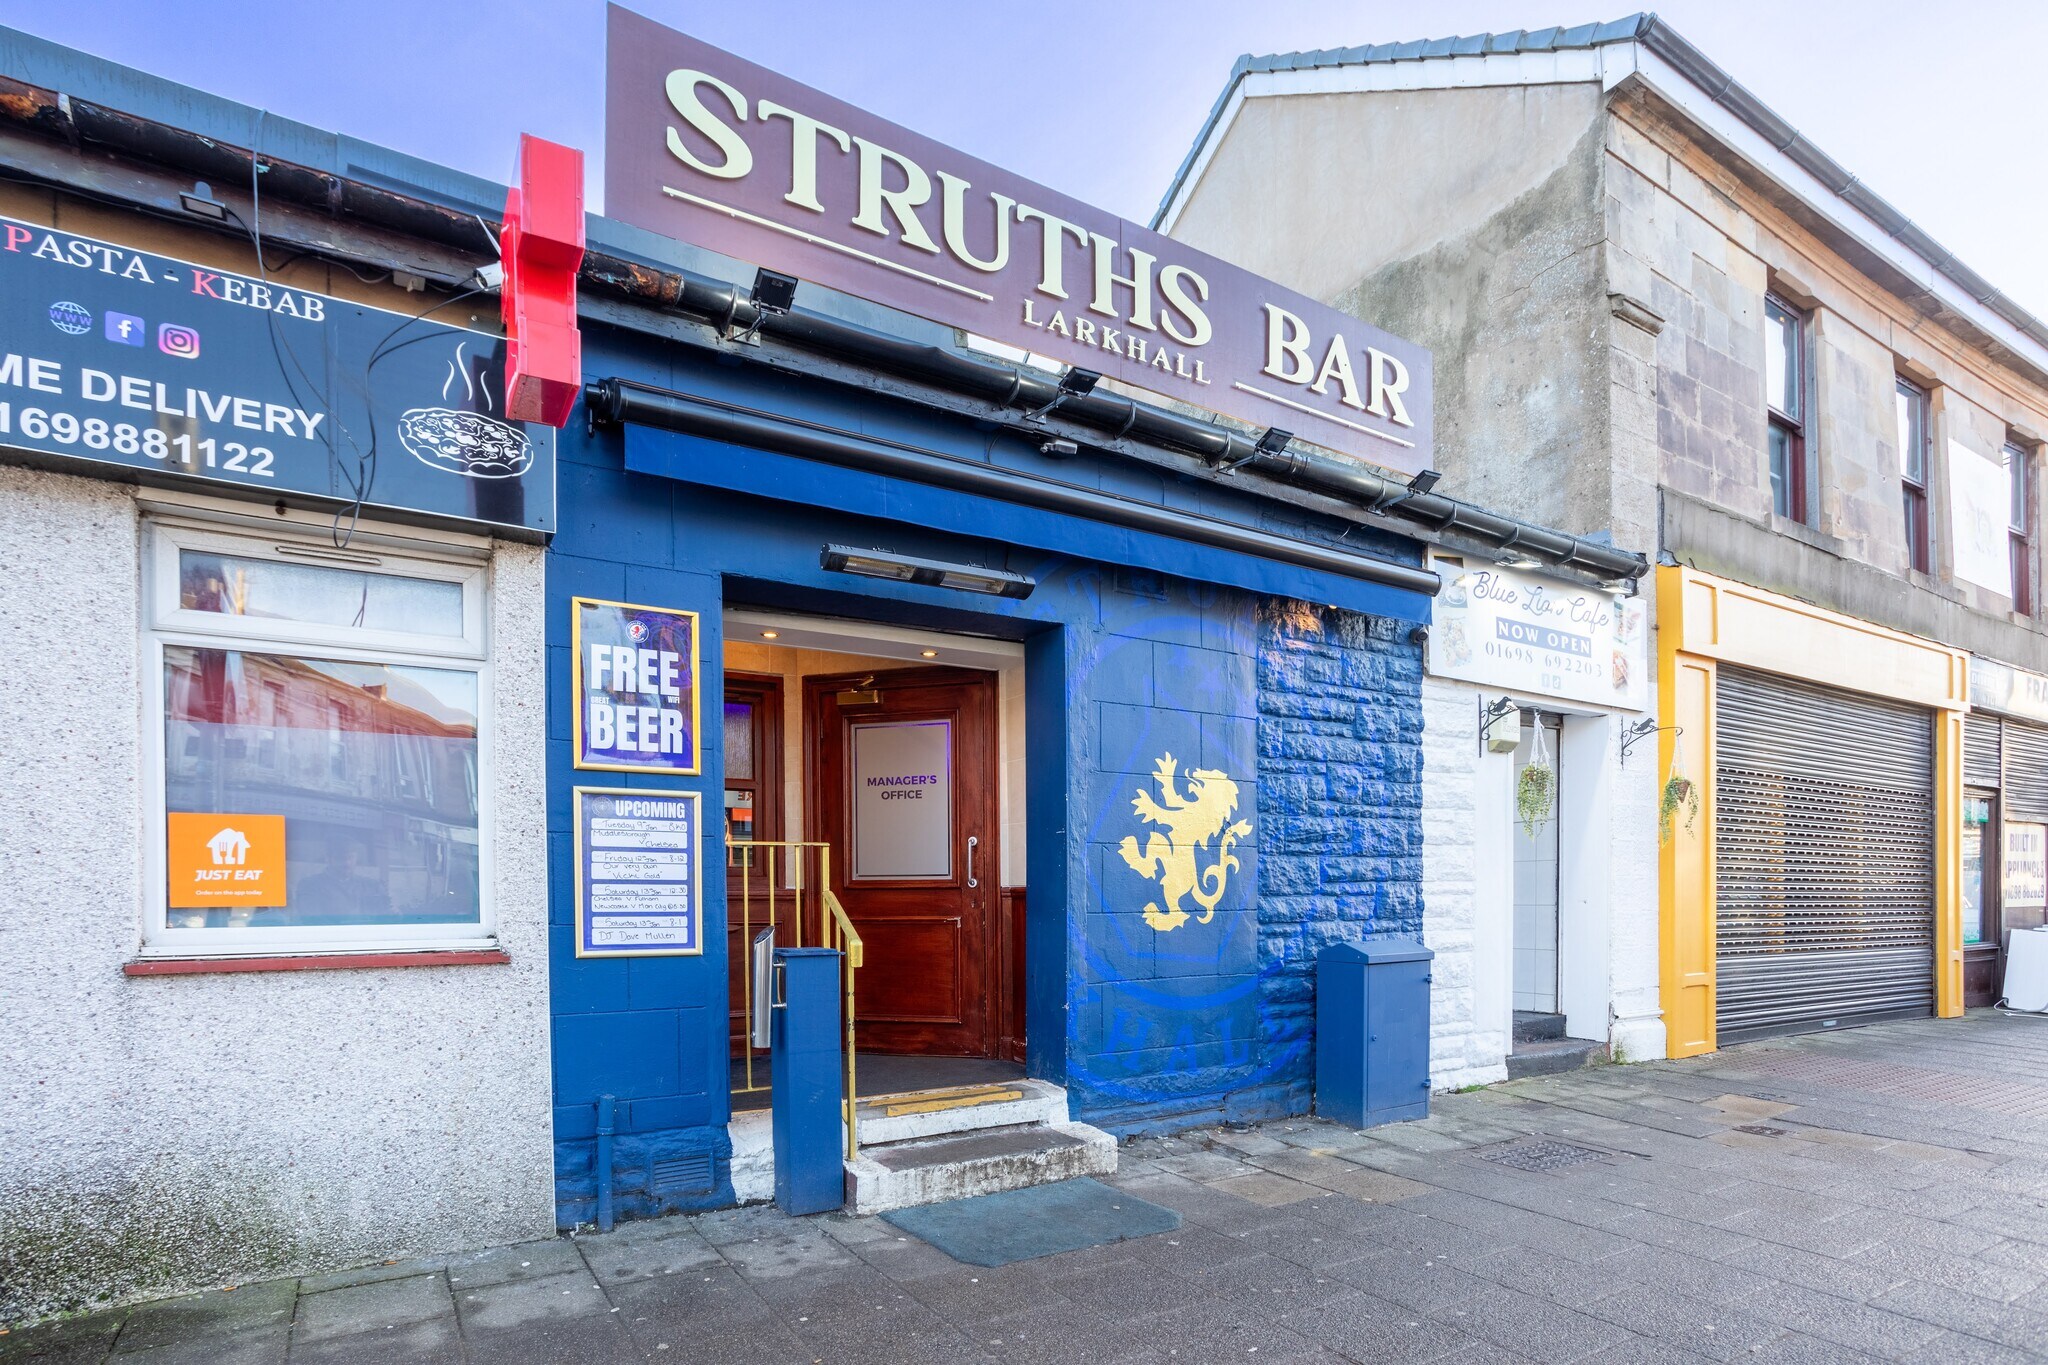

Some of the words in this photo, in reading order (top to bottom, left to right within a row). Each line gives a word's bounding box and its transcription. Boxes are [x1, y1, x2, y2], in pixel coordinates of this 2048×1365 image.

[3, 224, 155, 283] PASTA
[191, 269, 325, 322] KEBAB
[665, 69, 1212, 346] STRUTHS
[1264, 303, 1414, 427] BAR
[1024, 299, 1211, 385] LARKHALL
[82, 368, 324, 440] DELIVERY
[1473, 571, 1518, 604] Blue
[1567, 597, 1609, 634] Cafe
[1485, 641, 1533, 664] 01698
[1545, 654, 1602, 678] 692203
[1498, 621, 1540, 643] NOW
[1547, 633, 1590, 654] OPEN
[591, 643, 680, 696] FREE
[590, 704, 683, 754] BEER
[867, 775, 937, 786] MANAGER'S
[881, 790, 923, 800] OFFICE
[616, 800, 685, 818] UPCOMING
[194, 870, 232, 882] JUST
[234, 870, 263, 880] EAT
